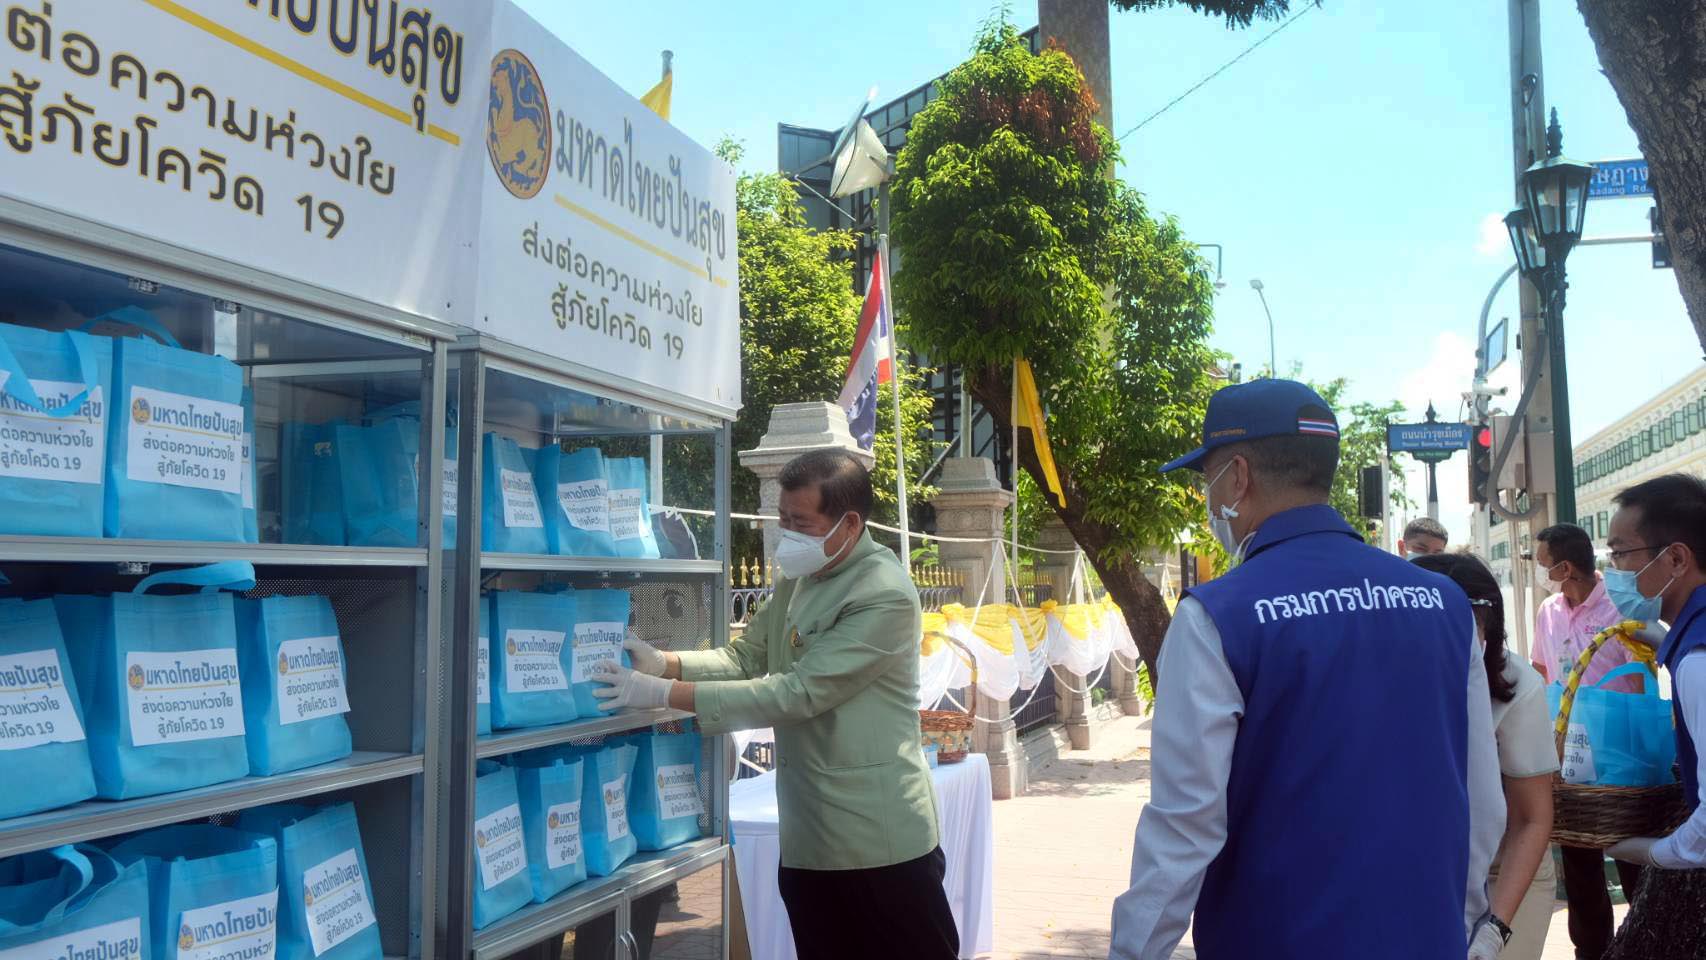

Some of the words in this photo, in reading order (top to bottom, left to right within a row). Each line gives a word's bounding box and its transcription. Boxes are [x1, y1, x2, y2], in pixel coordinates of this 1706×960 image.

[0, 71, 265, 216] สู้ภัยโควิด
[297, 194, 346, 239] 19
[554, 108, 727, 282] มหาดไทยปันสุข
[522, 221, 704, 327] ส่งต่อความห่วงใย
[551, 282, 652, 351] สู้ภัยโควิด
[663, 332, 685, 360] 19
[152, 404, 242, 441] มหาดไทยปันสุข
[64, 456, 82, 470] 19
[157, 455, 210, 478] สู้ภัยโควิด
[212, 467, 227, 481] 19
[1254, 577, 1444, 624] กรมการปกครอง
[146, 661, 238, 686] มหาดไทยปันสุข
[36, 720, 55, 735] 19
[158, 716, 208, 738] สู้ภัยโควิด
[210, 717, 225, 730] 19
